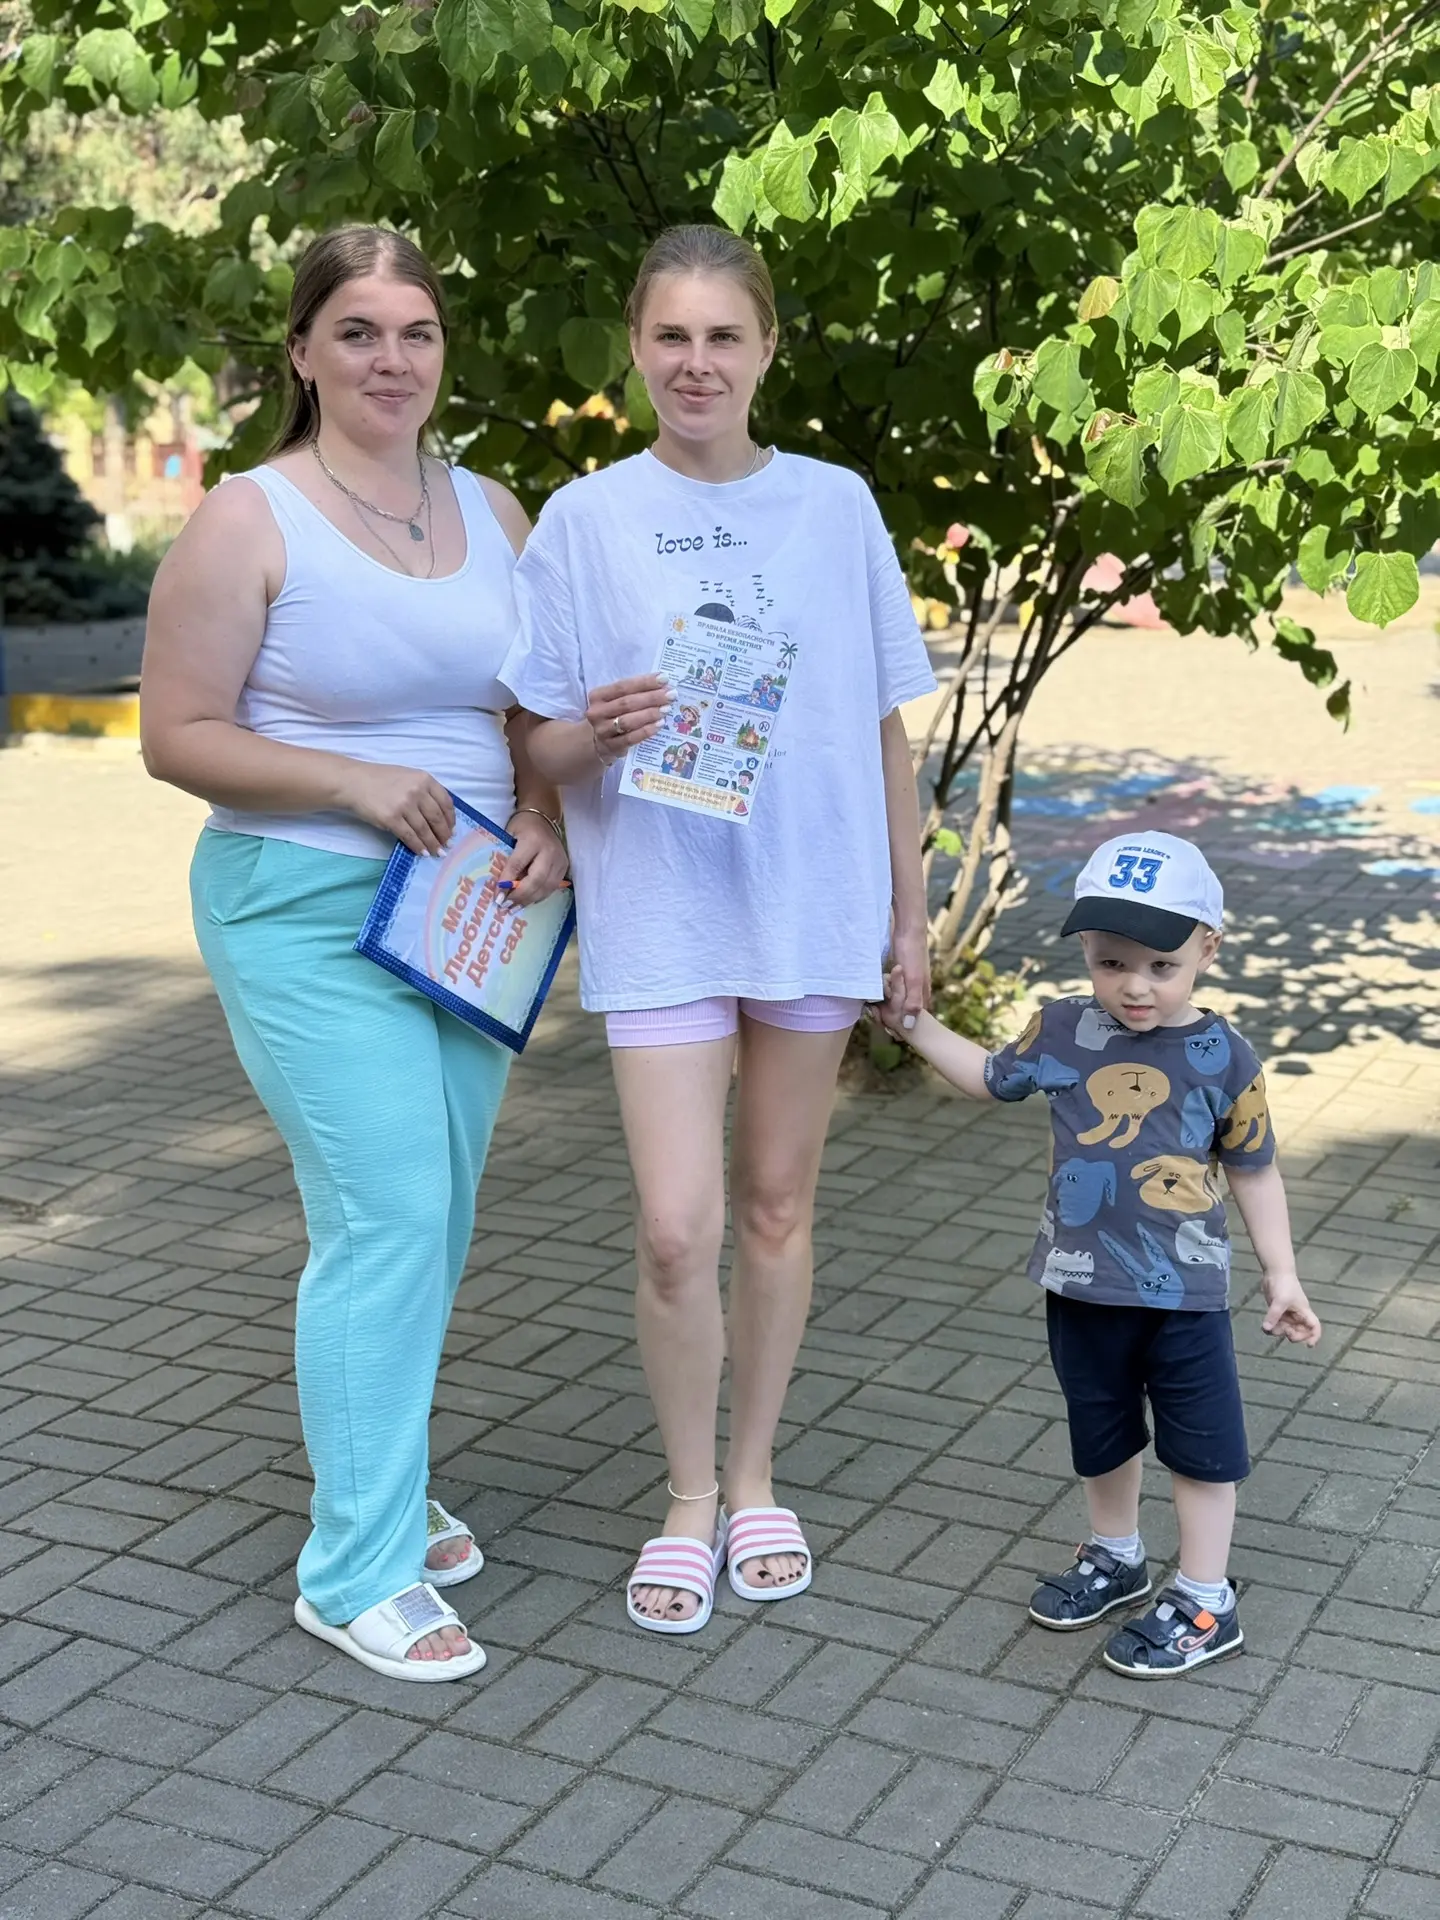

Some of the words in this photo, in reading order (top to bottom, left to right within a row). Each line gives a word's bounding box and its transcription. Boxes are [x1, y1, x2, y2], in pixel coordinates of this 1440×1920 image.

[655, 532, 704, 555] love
[712, 526, 748, 549] is...
[1108, 854, 1163, 893] 33
[440, 874, 477, 934] Мой
[465, 906, 511, 990] Детск
[499, 916, 529, 965] сад
